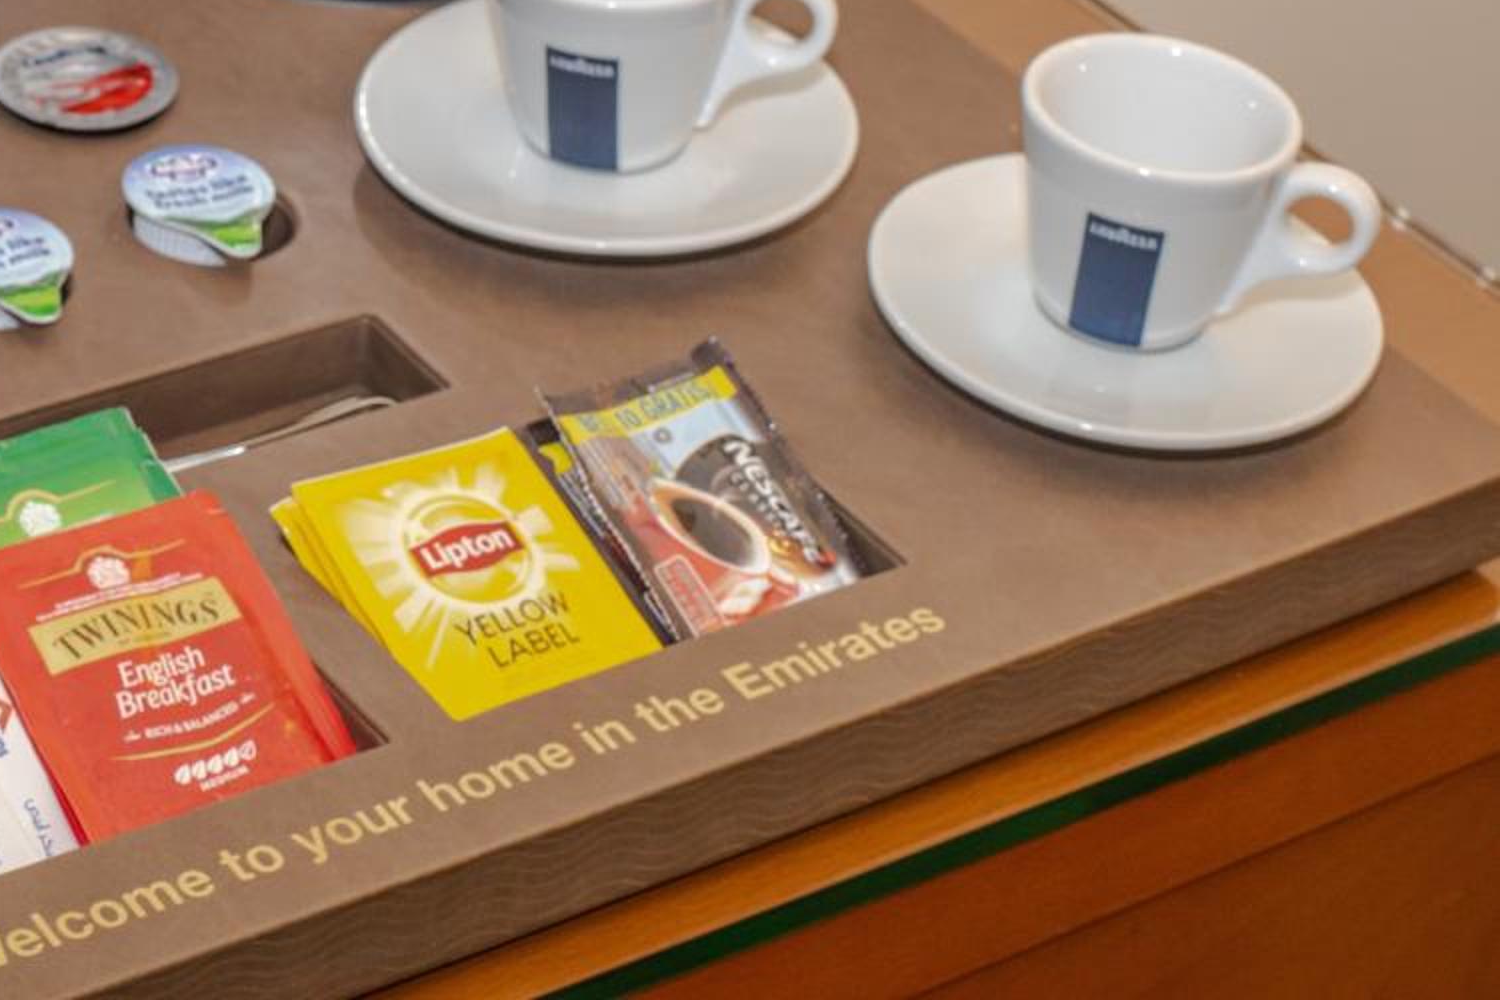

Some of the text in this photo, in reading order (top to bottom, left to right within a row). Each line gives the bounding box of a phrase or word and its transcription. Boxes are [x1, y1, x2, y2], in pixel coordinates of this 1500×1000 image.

[420, 529, 515, 570] Lipton
[53, 596, 220, 659] TWININGS
[453, 591, 570, 645] YELLOW
[487, 621, 580, 668] LABEL
[115, 665, 236, 719] Breakfast
[117, 645, 205, 688] English
[219, 843, 284, 881] to
[291, 795, 414, 865] your
[415, 741, 576, 812] home
[573, 721, 636, 755] in
[635, 685, 725, 734] the
[721, 605, 946, 700] Emirates
